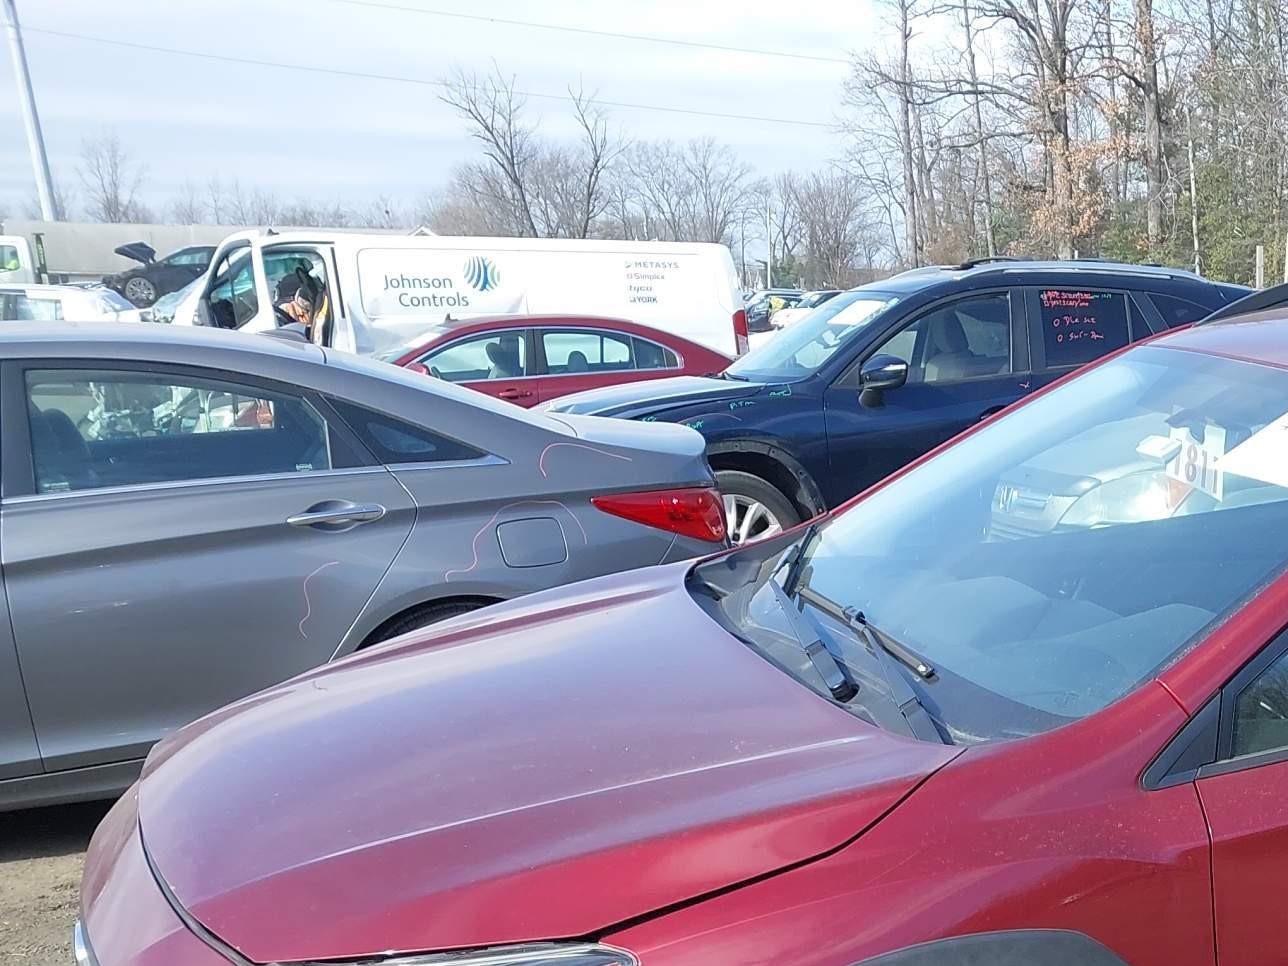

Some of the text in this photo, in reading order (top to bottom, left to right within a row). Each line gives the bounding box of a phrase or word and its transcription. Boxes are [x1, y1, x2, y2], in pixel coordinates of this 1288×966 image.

[634, 261, 679, 269] METASYS
[384, 273, 453, 291] Johnson
[398, 292, 470, 308] Controls
